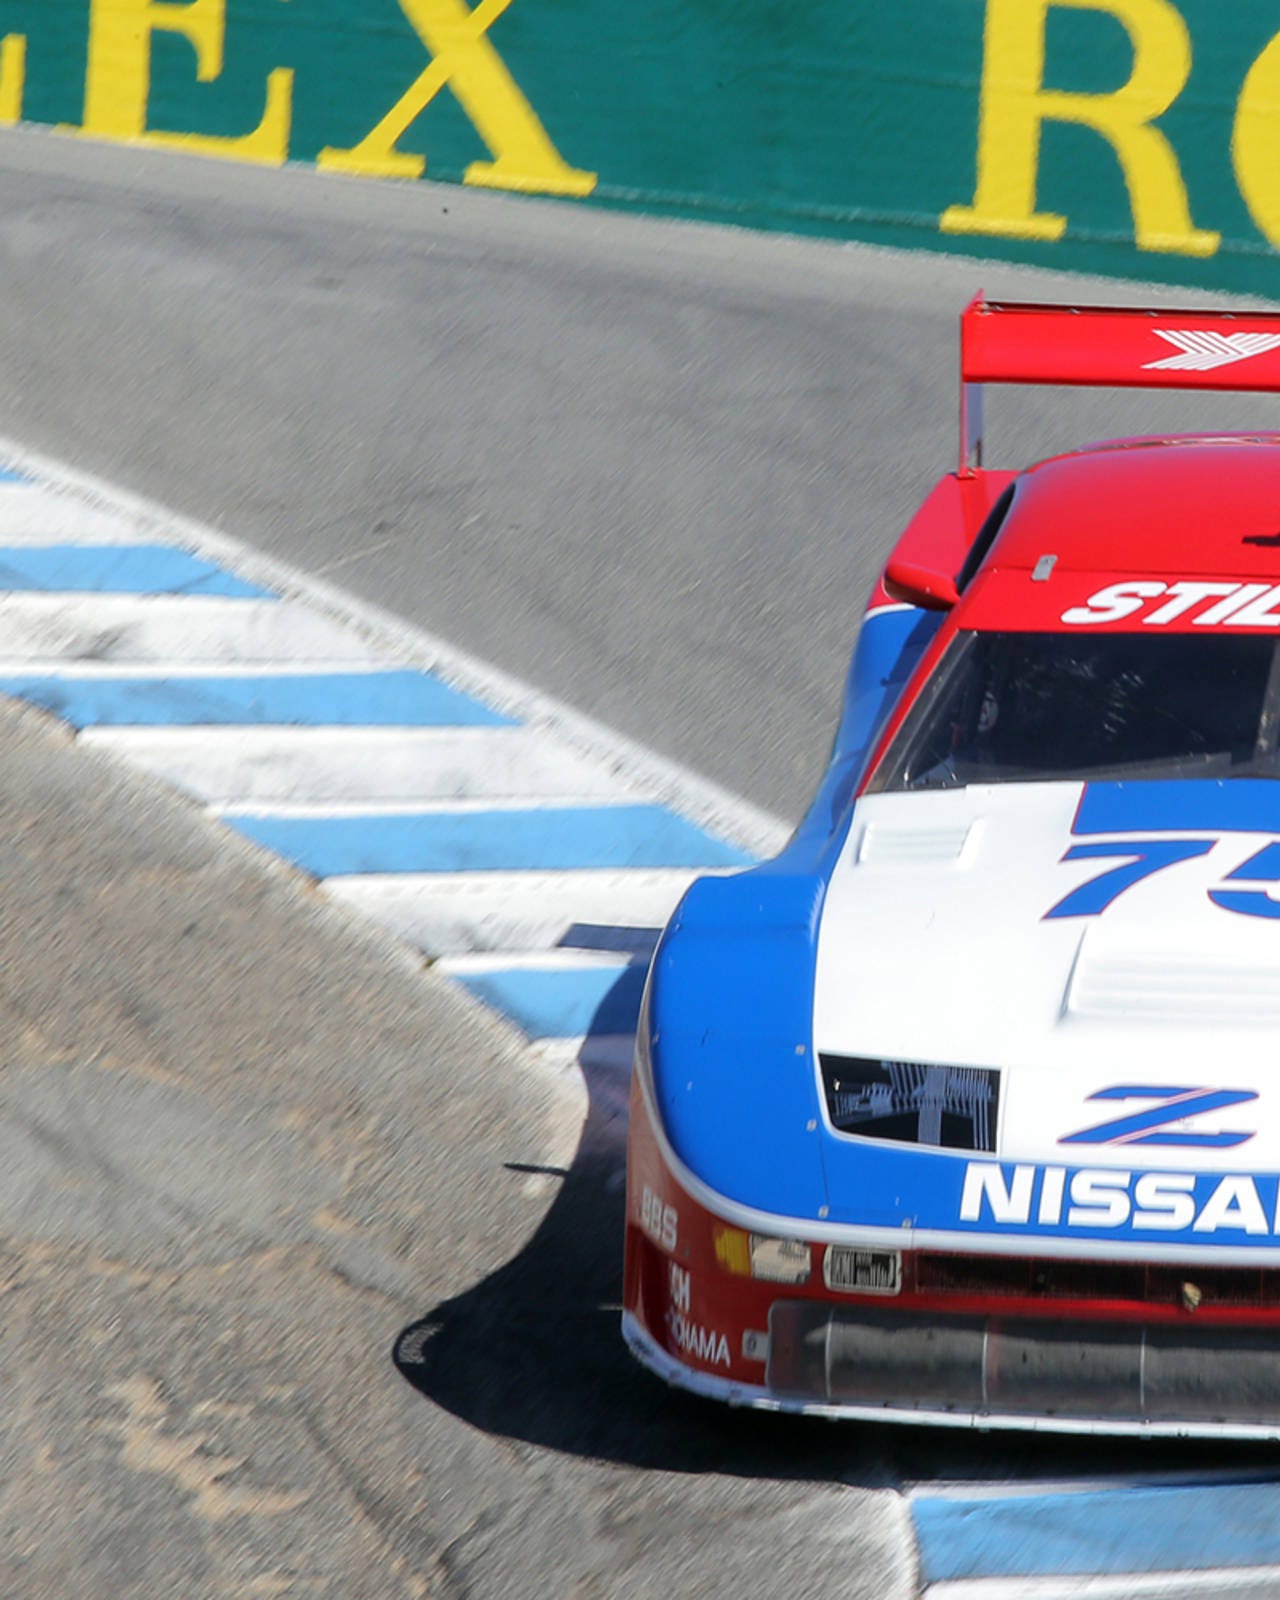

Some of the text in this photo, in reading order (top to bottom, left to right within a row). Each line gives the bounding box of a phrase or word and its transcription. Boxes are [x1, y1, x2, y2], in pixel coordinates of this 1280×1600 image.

[0, 0, 597, 196] EX
[1056, 1084, 1261, 1148] Z
[641, 1185, 679, 1252] BBS
